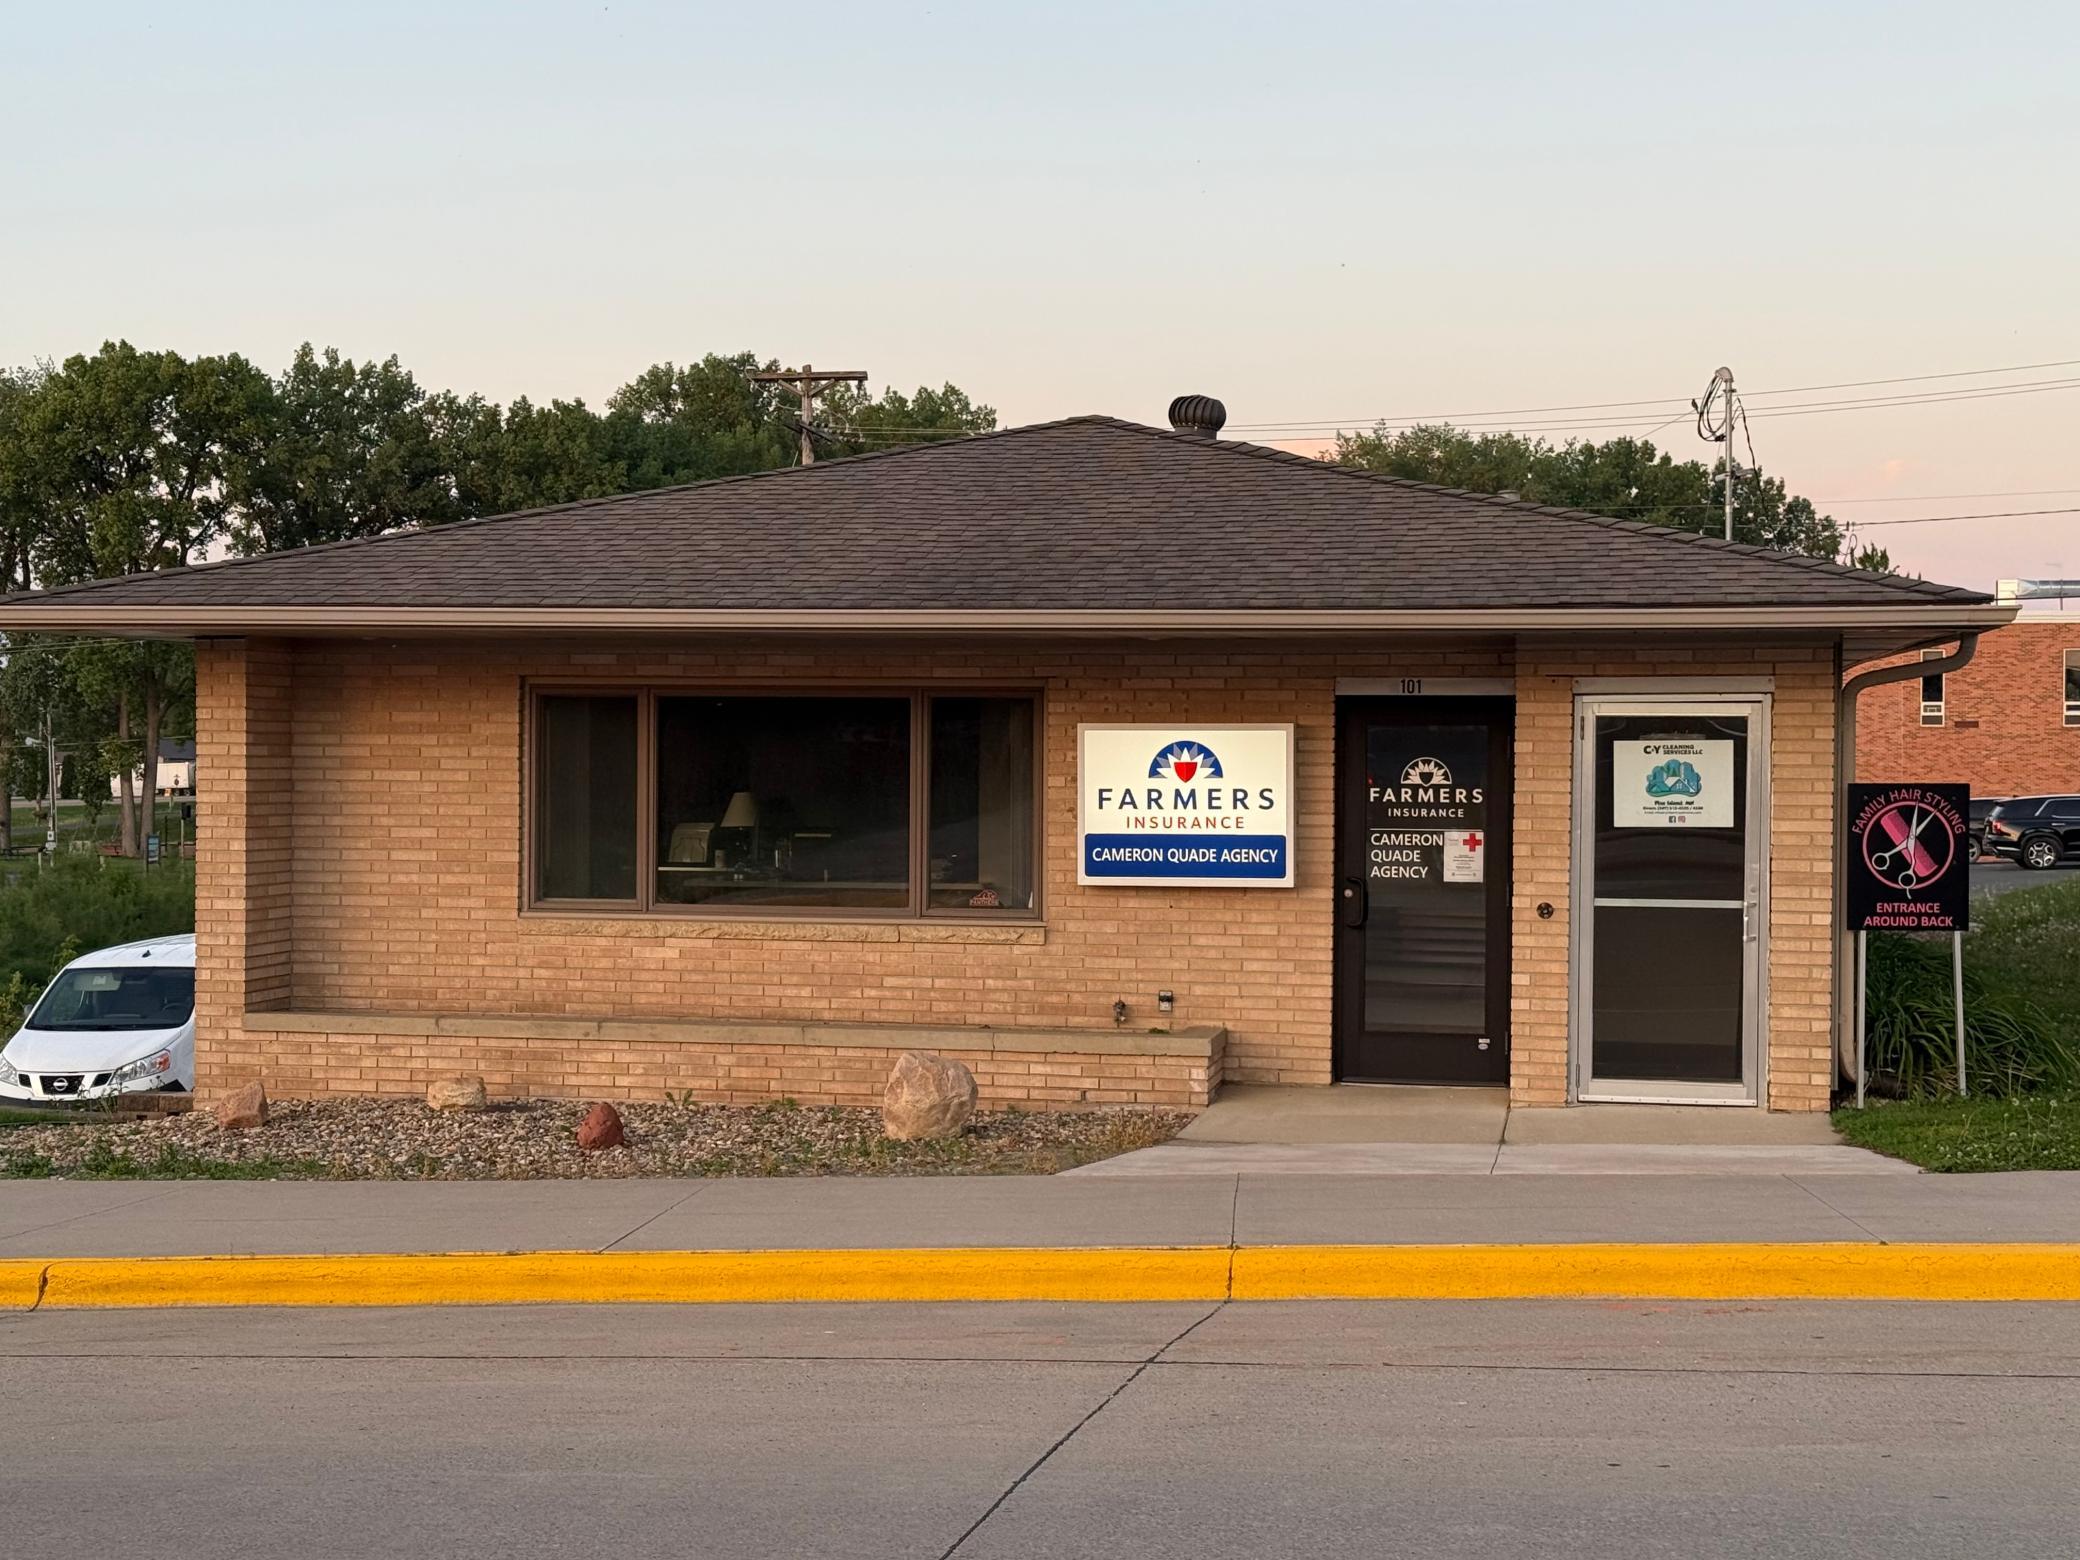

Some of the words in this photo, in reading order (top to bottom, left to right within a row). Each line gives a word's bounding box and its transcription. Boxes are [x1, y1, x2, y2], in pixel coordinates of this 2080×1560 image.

[1400, 679, 1422, 694] 101
[1098, 788, 1275, 810] FARMERS
[1369, 787, 1483, 803] FARMERS
[1388, 807, 1464, 818] INSURANCE
[1852, 794, 1886, 834] FAMILY
[1889, 788, 1921, 801] HAIR
[1924, 792, 1966, 834] STYLING
[1126, 816, 1245, 829] INSURANCE
[1370, 833, 1443, 846] CAMERON
[1092, 848, 1163, 862] CAMERON
[1167, 848, 1217, 864] QUADE
[1220, 849, 1278, 863] AGENCY
[1370, 849, 1421, 863] QUADE
[1370, 866, 1428, 878] AGENCY
[1876, 902, 1940, 913] ENTRANCE
[1864, 916, 1918, 926] AROUND
[1921, 916, 1953, 926] BACK
